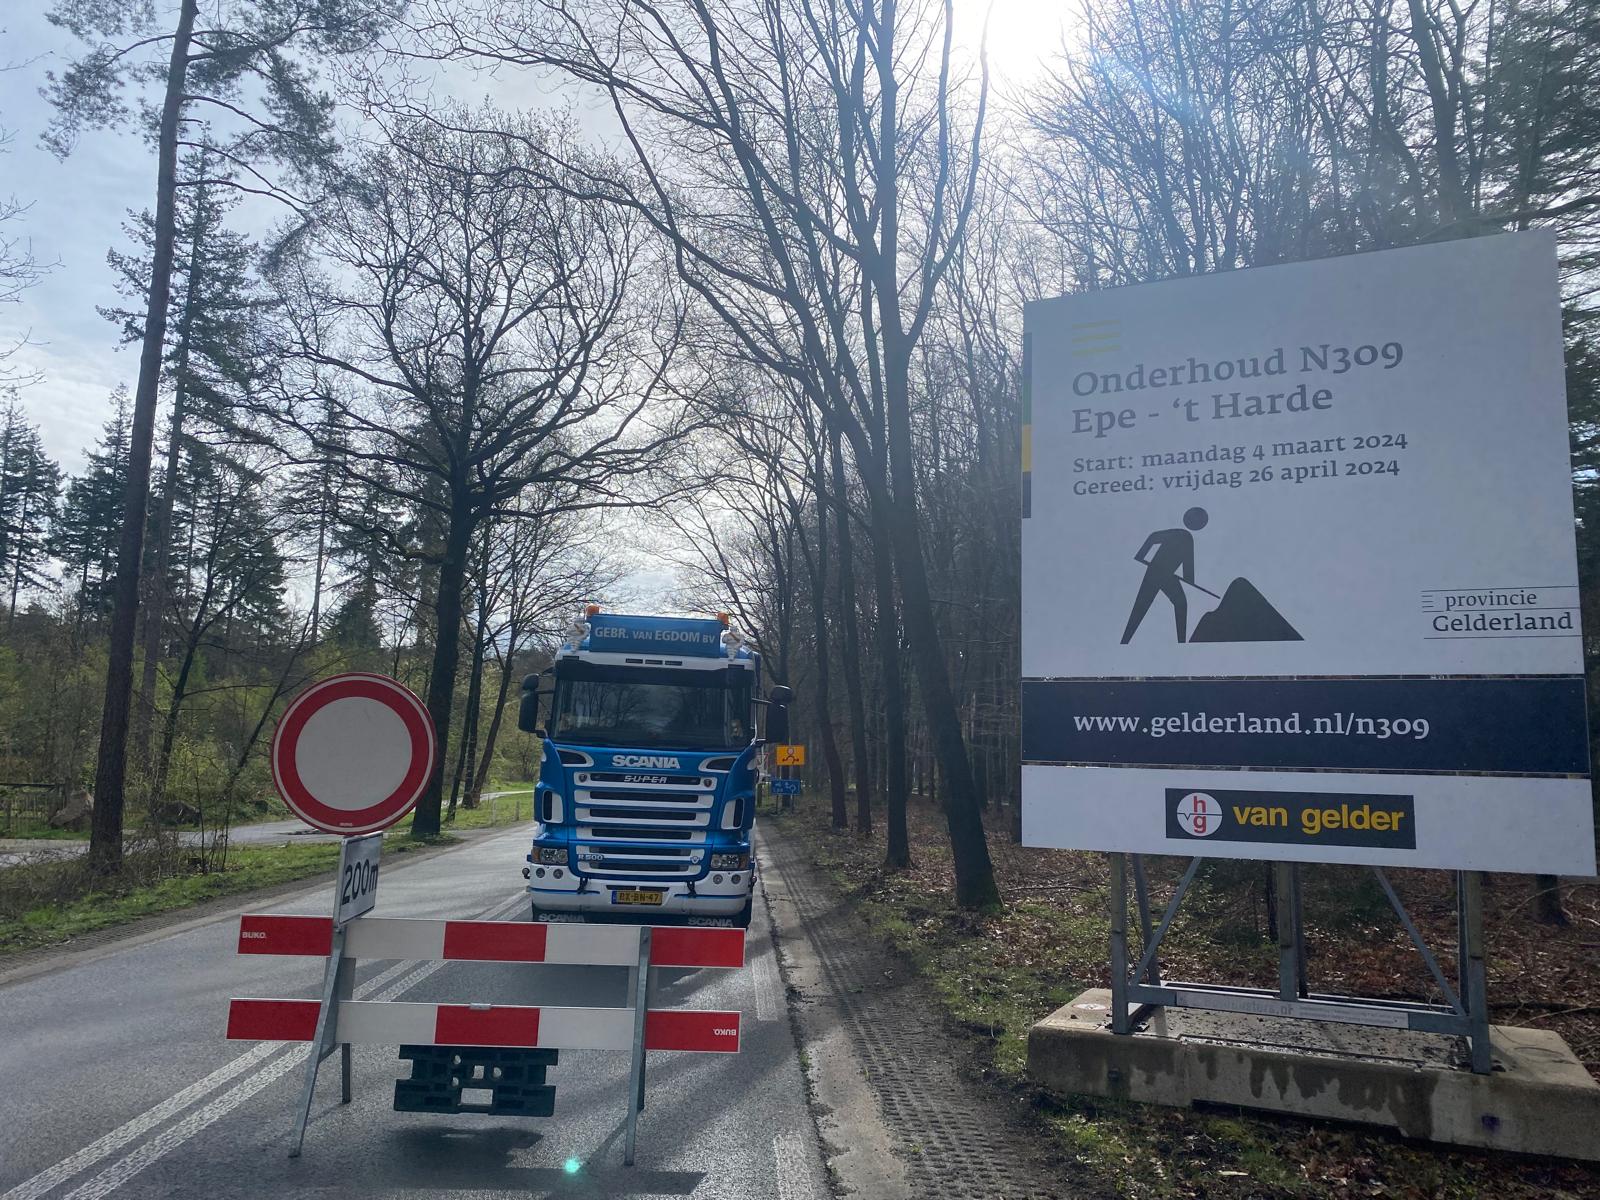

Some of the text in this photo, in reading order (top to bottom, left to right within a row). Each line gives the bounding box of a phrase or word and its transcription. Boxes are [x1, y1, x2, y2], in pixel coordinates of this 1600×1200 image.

[1072, 342, 1403, 397] Onderhoud N309
[1072, 407, 1137, 438] Epe
[1212, 384, 1333, 420] Harde
[1073, 433, 1408, 473] Start: maandag 4 maart 2024
[1073, 459, 1401, 496] Gereed: vrijdag 26 april 2024
[1445, 590, 1537, 611] provincie
[594, 627, 715, 644] GEBR. VAN EGDOM BV
[1432, 612, 1574, 632] Gelderland
[1073, 712, 1430, 740] www.gelderland.nl/n309
[611, 755, 680, 769] SCANIA
[1232, 804, 1405, 835] van gelder
[341, 859, 379, 905] 200m
[538, 913, 585, 923] SCANIA
[687, 917, 734, 927] SCANIA
